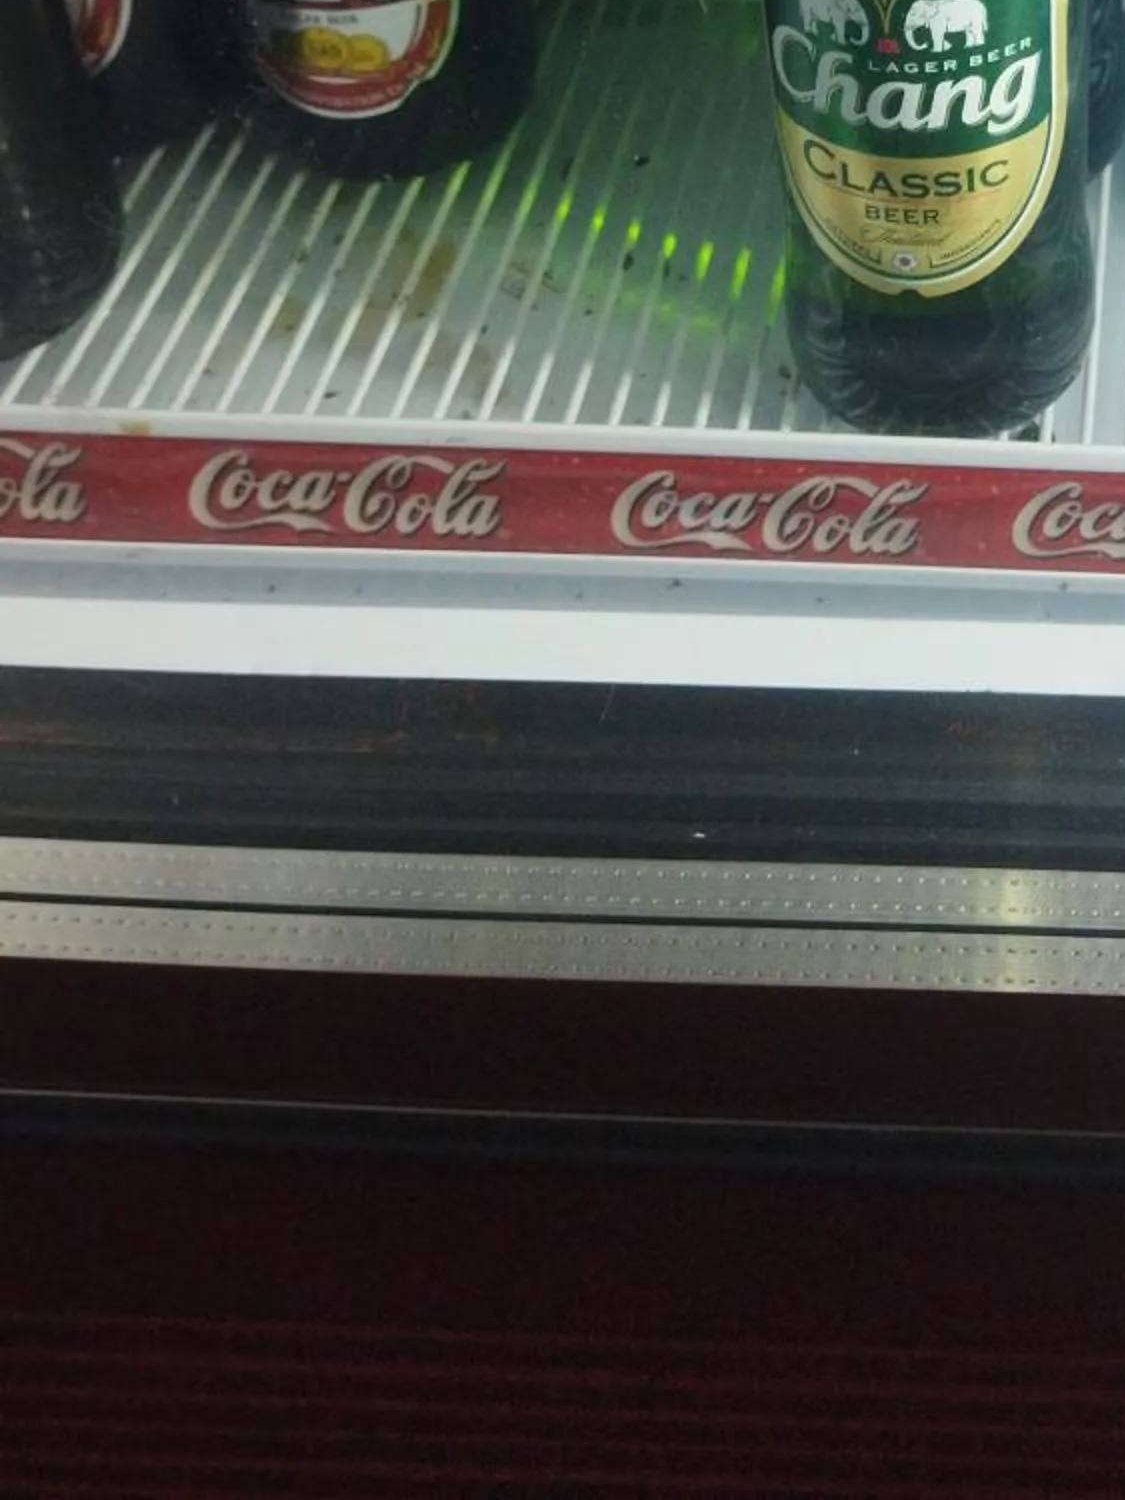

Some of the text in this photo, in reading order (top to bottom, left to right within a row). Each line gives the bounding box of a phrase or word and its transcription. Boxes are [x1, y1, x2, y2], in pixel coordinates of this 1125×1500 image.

[771, 24, 1043, 137] Chang
[867, 37, 1033, 75] LAGER BEER
[803, 138, 1011, 199] CLASSIC
[864, 205, 940, 226] BEER
[188, 448, 509, 538] Coca-Cola
[610, 468, 929, 556] Coca-Cola
